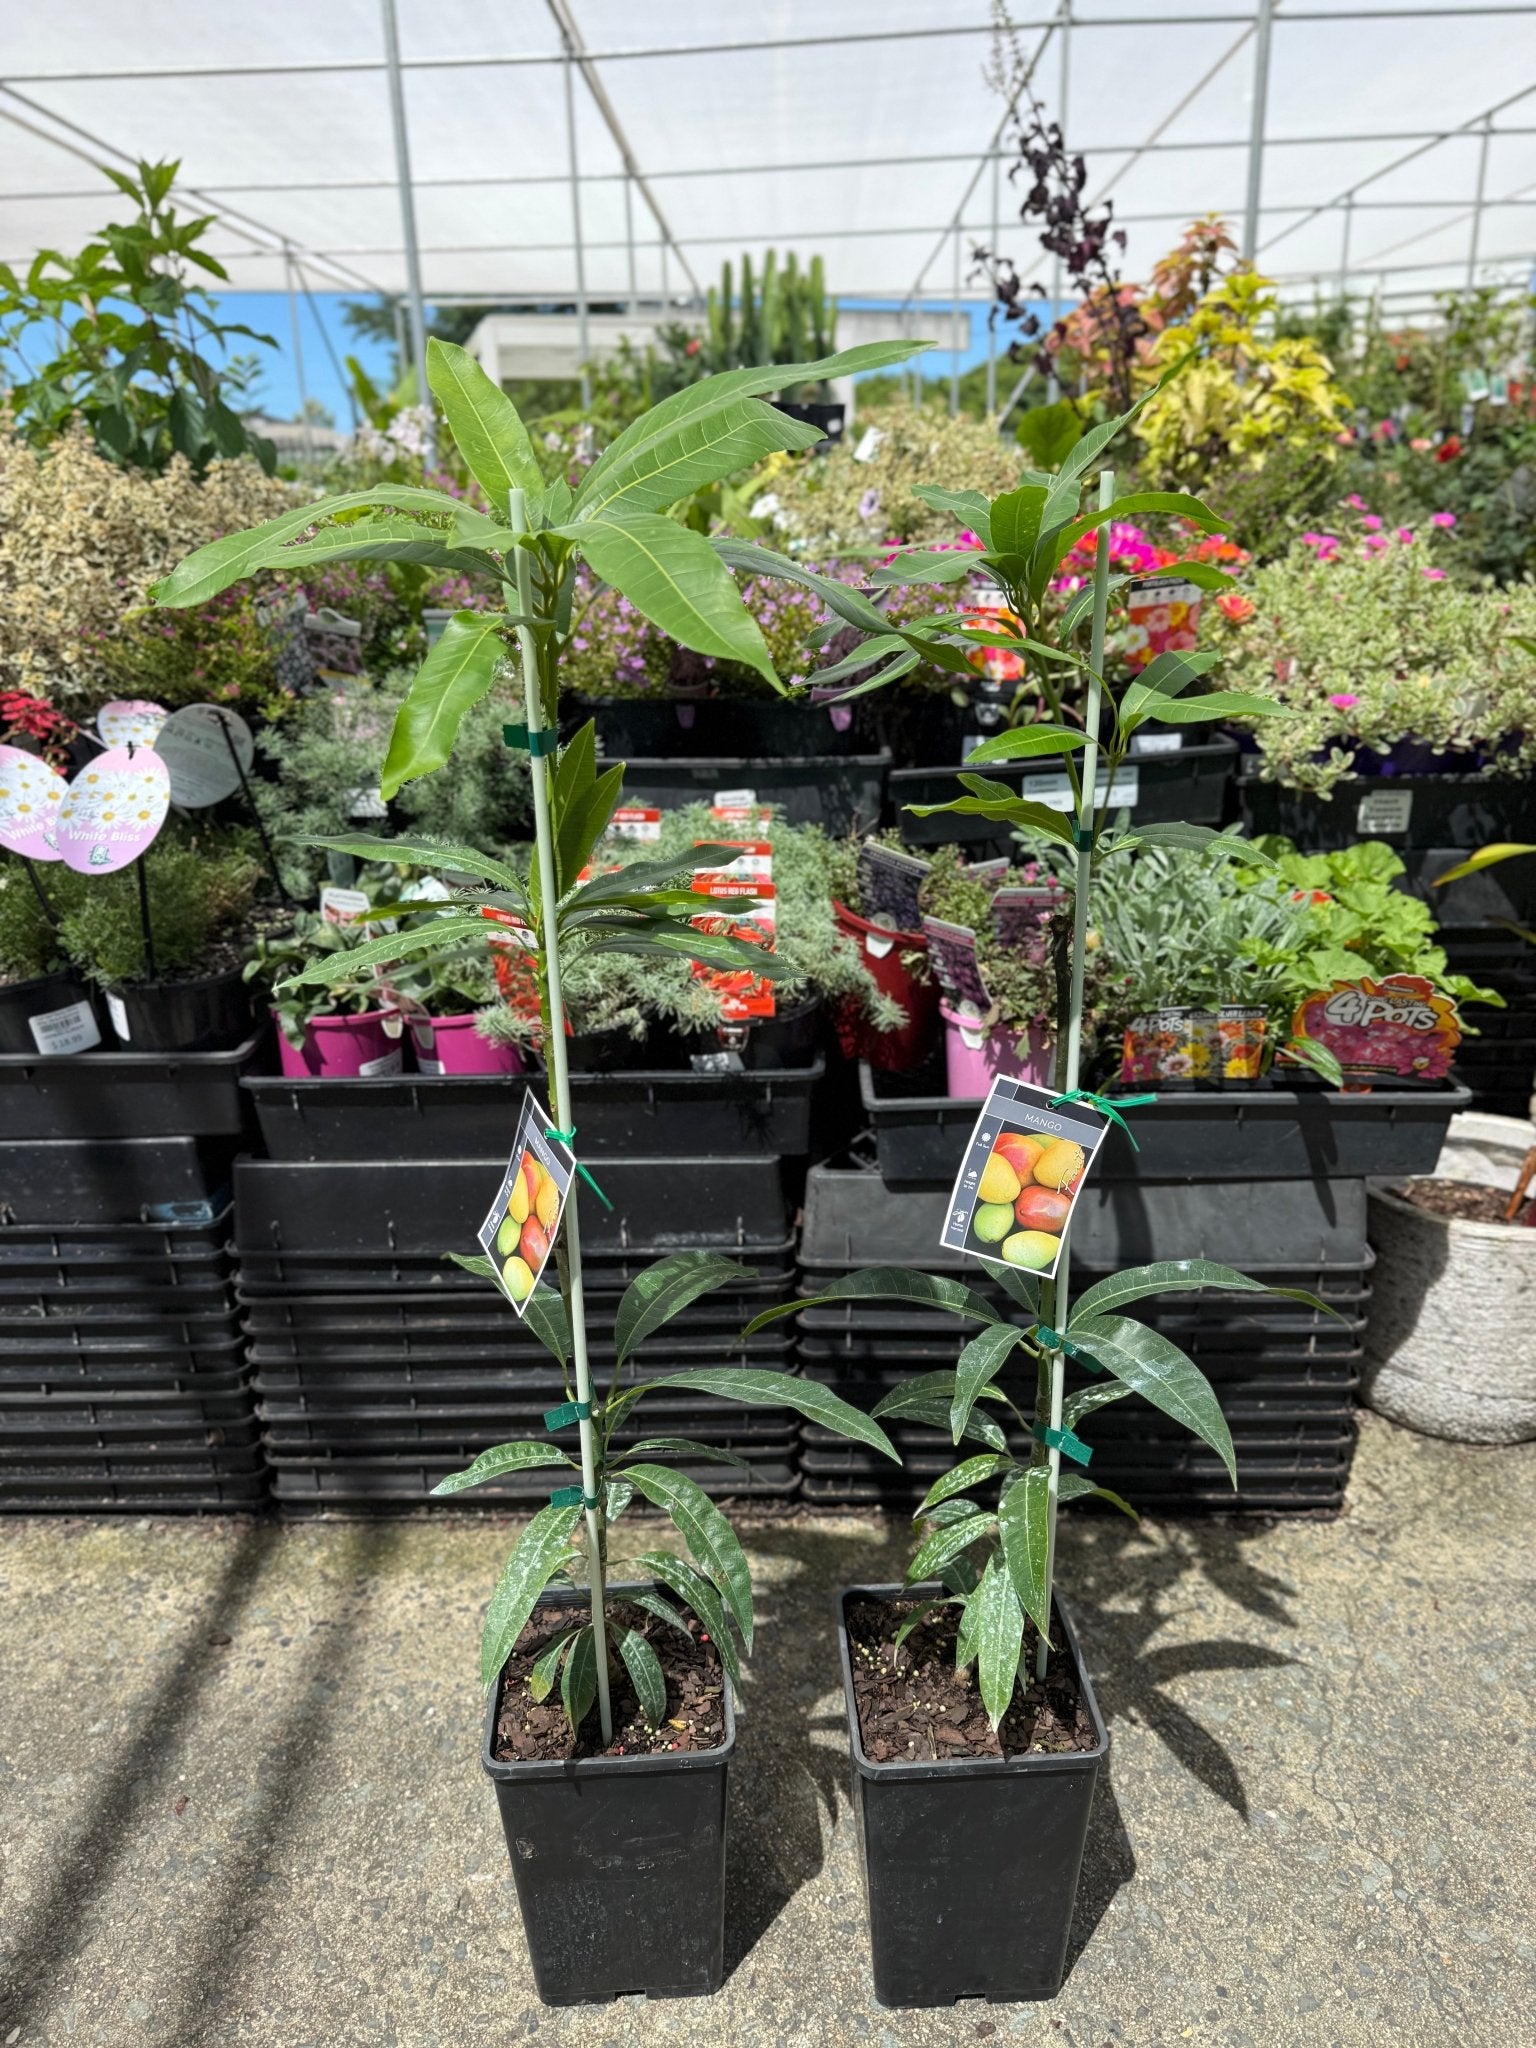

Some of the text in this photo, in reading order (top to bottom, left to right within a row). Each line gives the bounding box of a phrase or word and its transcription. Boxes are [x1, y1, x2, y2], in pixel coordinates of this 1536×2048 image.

[8, 821, 45, 841] White
[68, 830, 142, 843] White Bliss
[710, 886, 758, 896] LOTUS RED FLASH
[1326, 989, 1439, 1030] 4 POTS
[1129, 1016, 1184, 1036] 4 POTS
[1025, 1113, 1062, 1132] MANGO
[534, 1136, 551, 1166] MANGO
